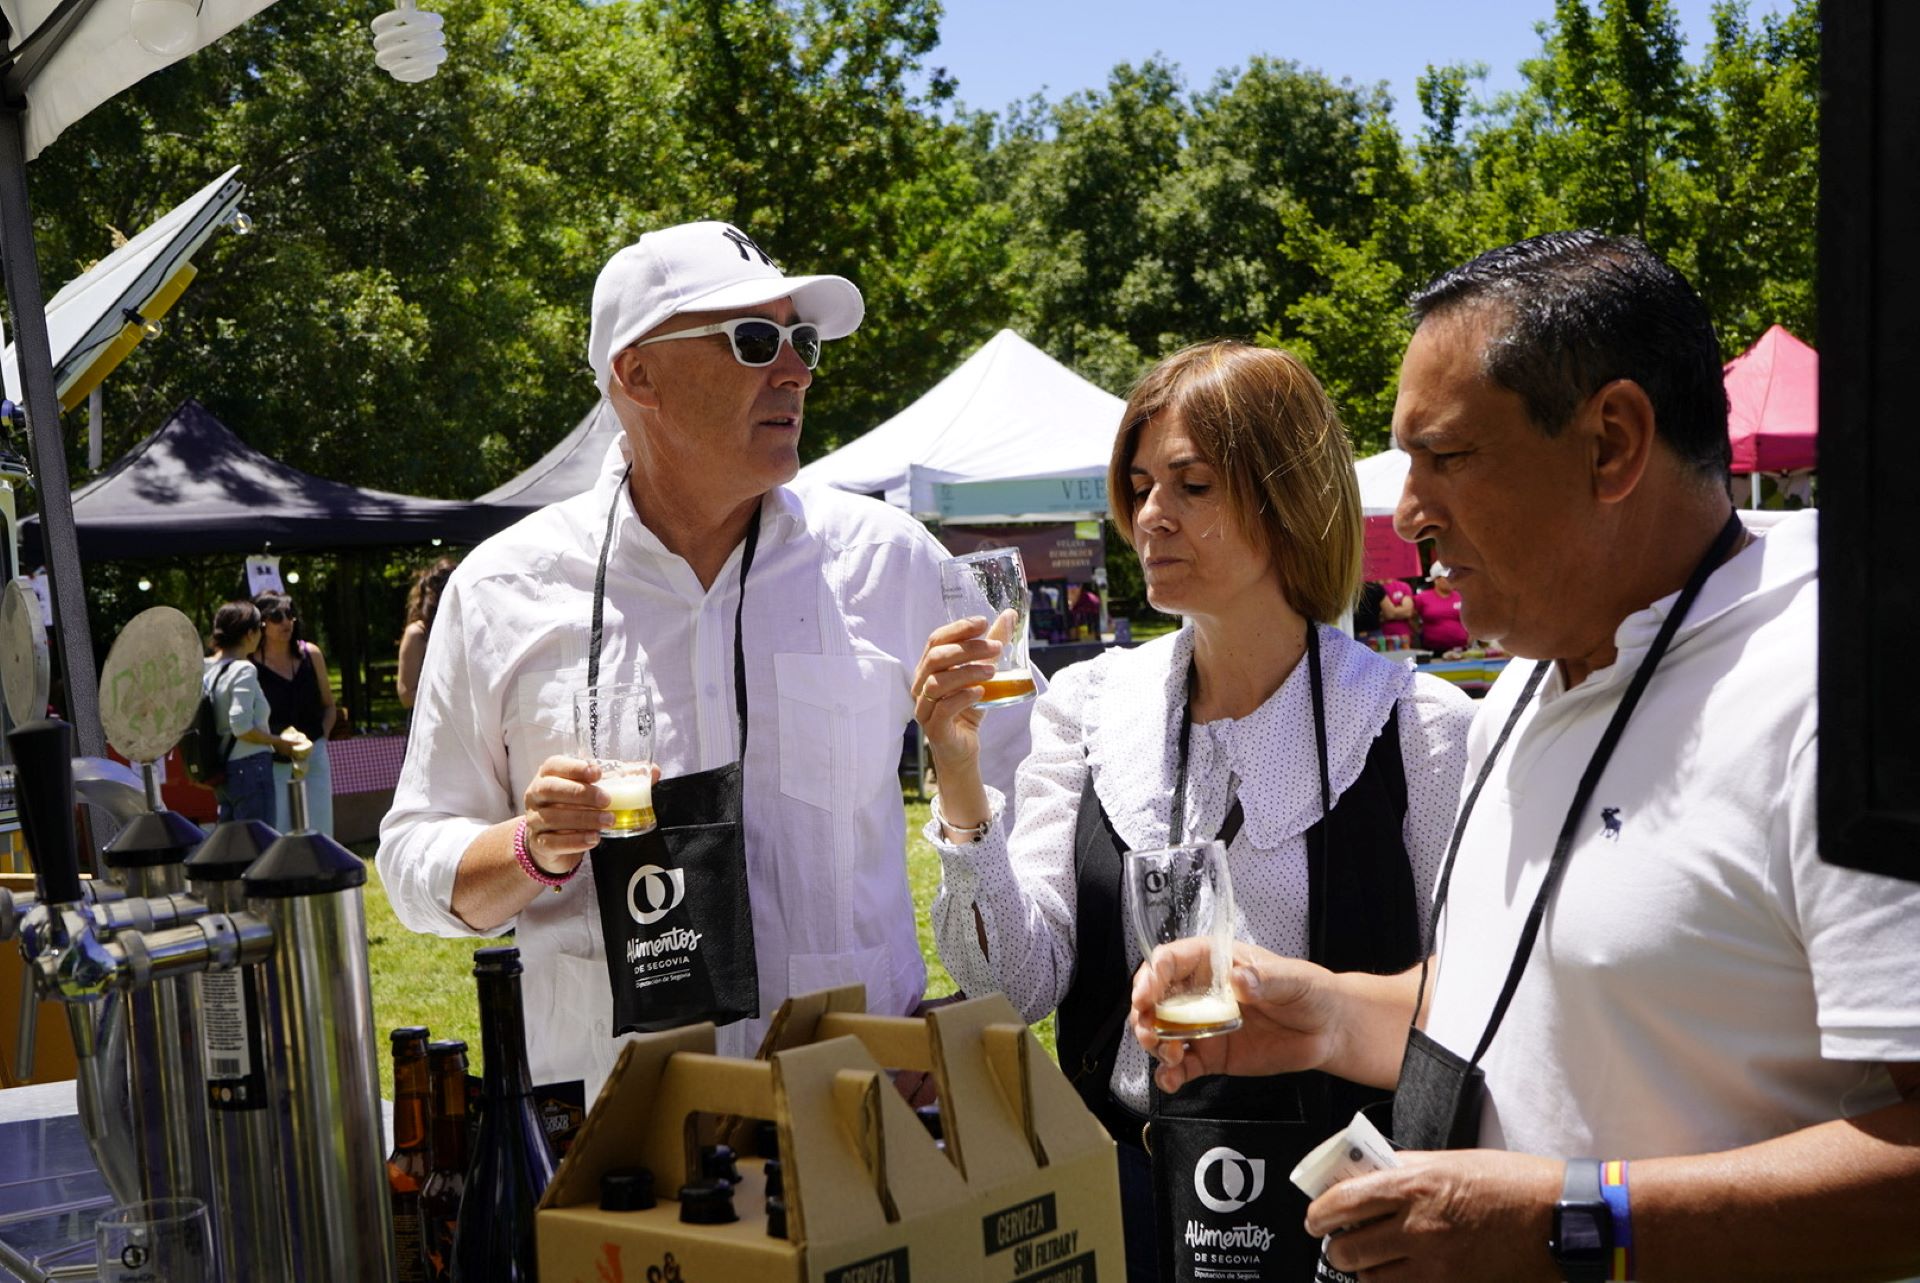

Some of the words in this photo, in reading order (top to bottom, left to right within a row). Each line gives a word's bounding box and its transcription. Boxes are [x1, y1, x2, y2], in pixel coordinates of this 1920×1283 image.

[626, 926, 703, 963] Alimentos
[634, 964, 645, 975] DE
[647, 956, 690, 971] SEGOVIA
[997, 1202, 1044, 1246] CERVEZA
[1185, 1220, 1275, 1251] Alimentos
[1014, 1240, 1033, 1276] SIN
[1194, 1252, 1208, 1263] DE
[1210, 1254, 1261, 1264] SEGOVIA
